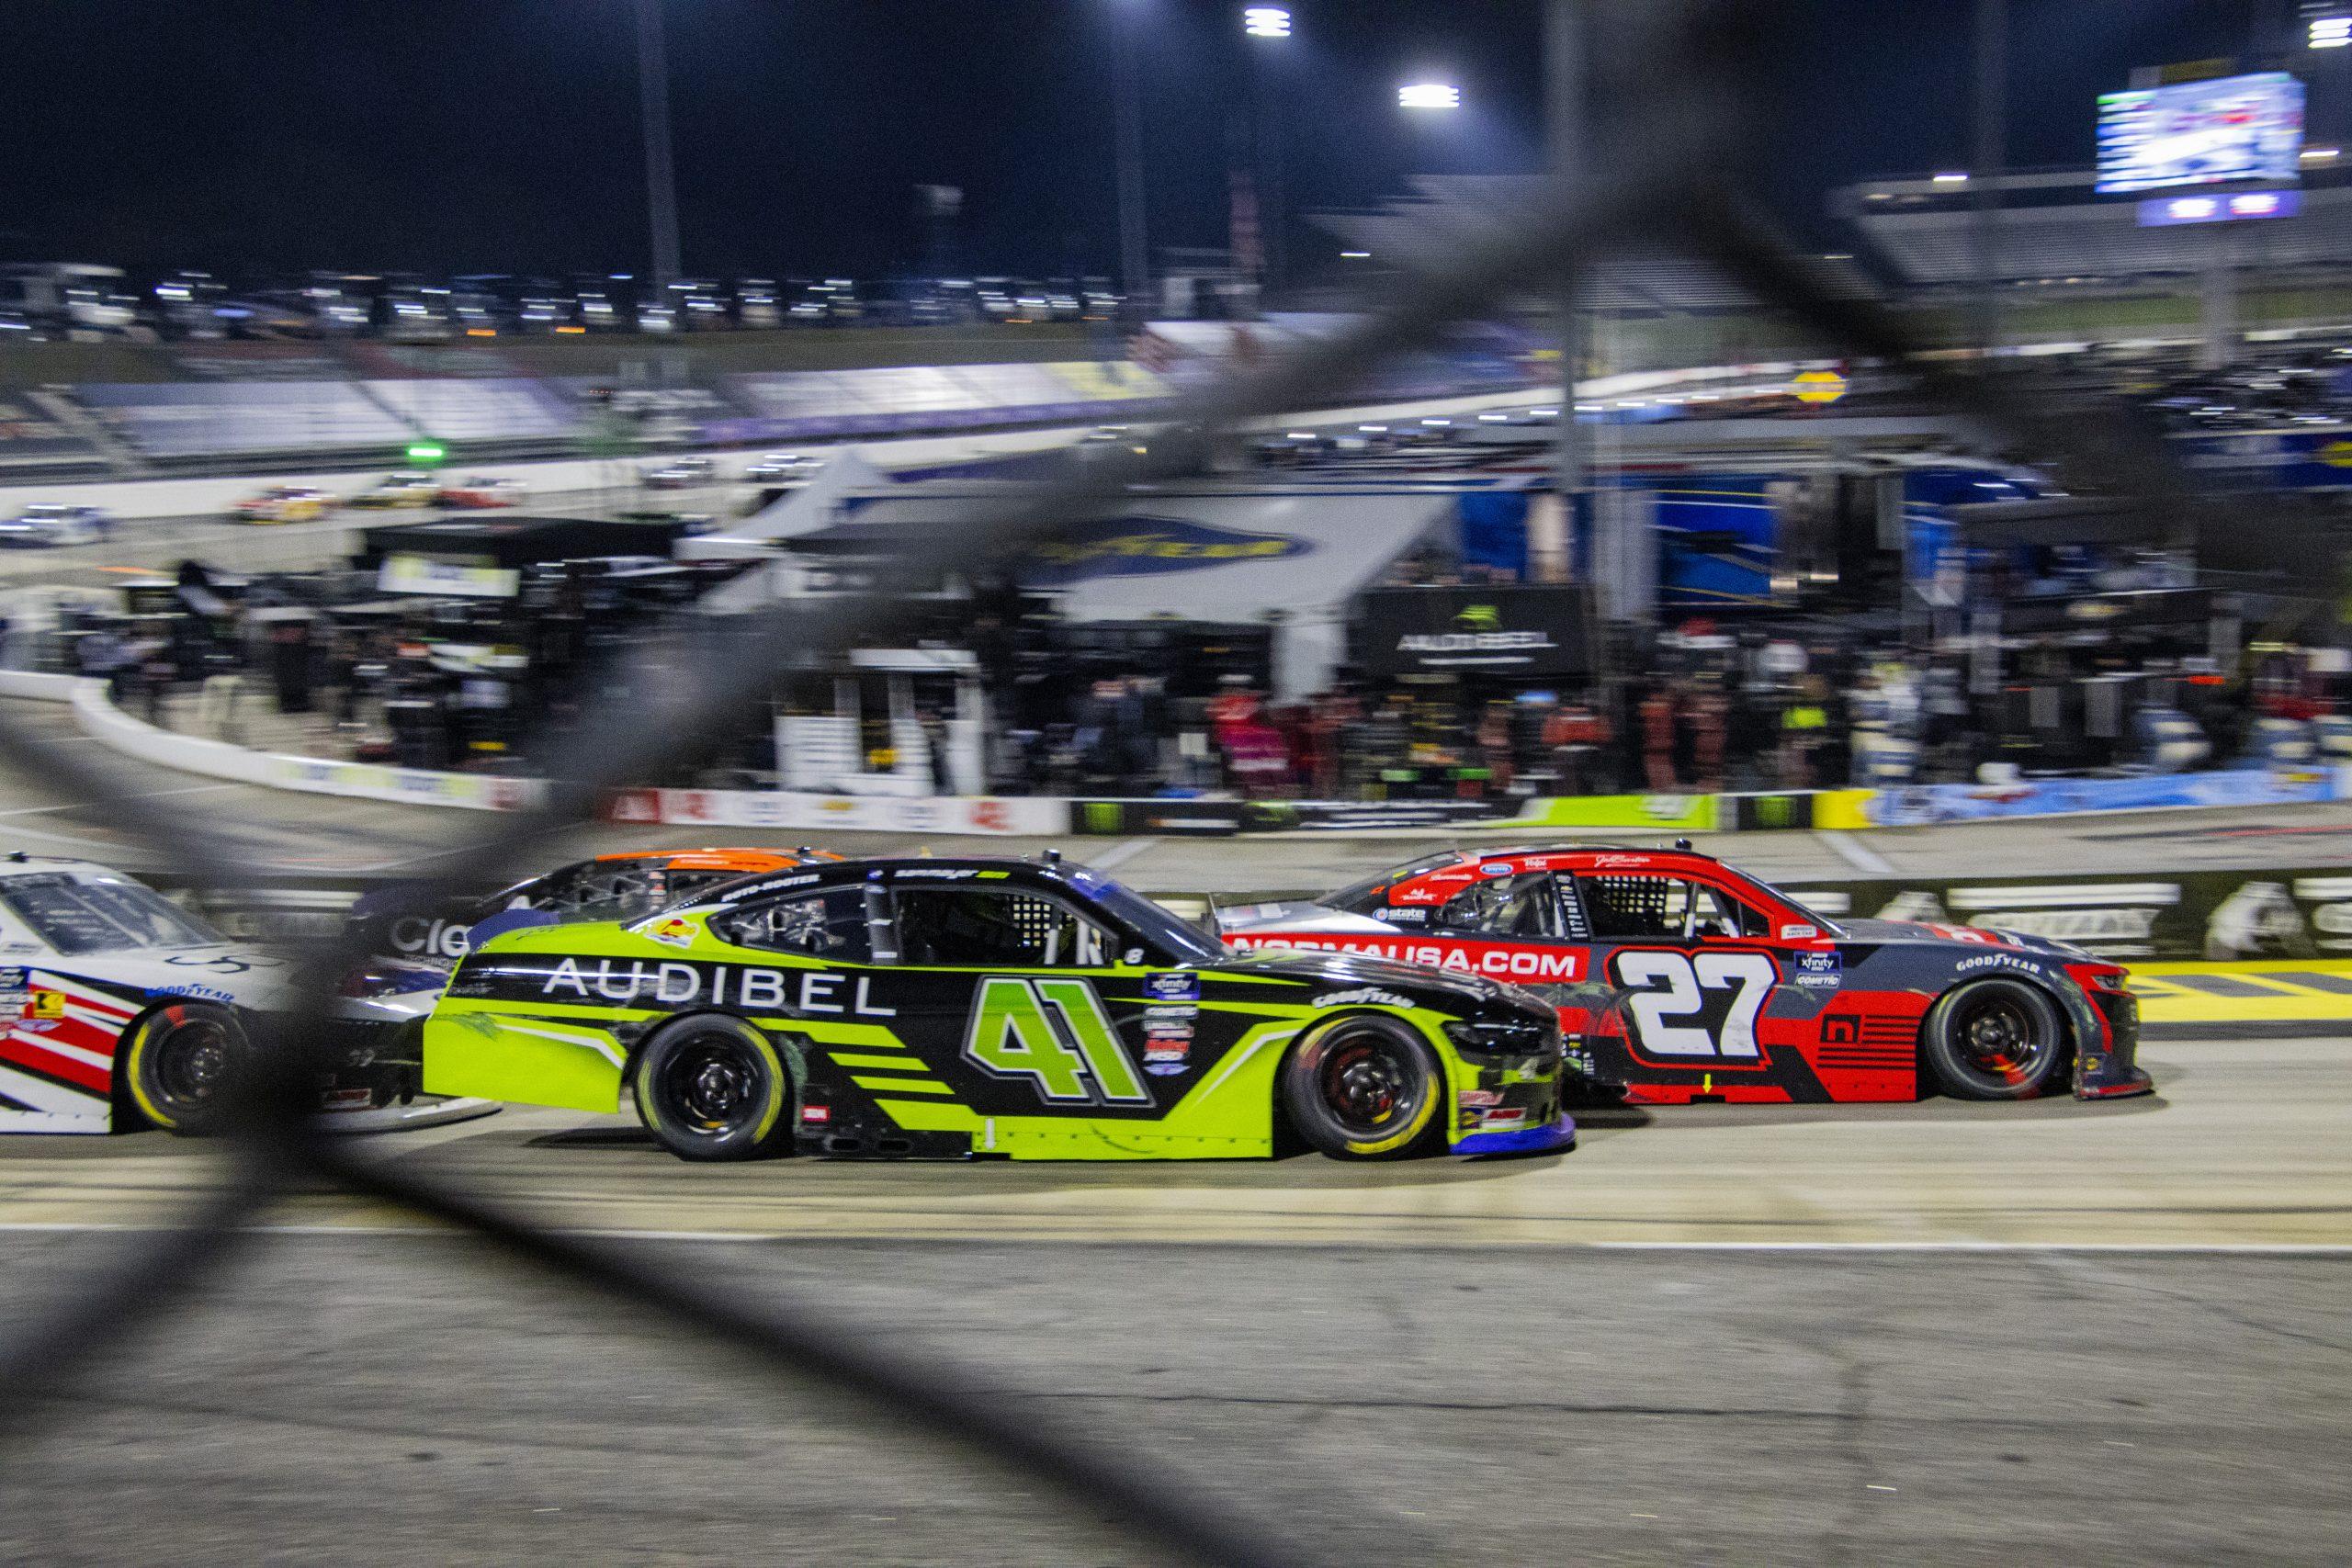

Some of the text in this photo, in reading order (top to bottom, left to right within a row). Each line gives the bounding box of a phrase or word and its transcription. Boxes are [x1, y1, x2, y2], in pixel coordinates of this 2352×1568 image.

[1802, 957, 1834, 970] xfinity
[1956, 953, 2041, 974] GOODYEAR
[542, 957, 897, 1016] AUDIBEL
[1311, 987, 1416, 1010] GOODYEAR
[1617, 952, 1776, 1056] 27
[965, 976, 1151, 1103] 41
